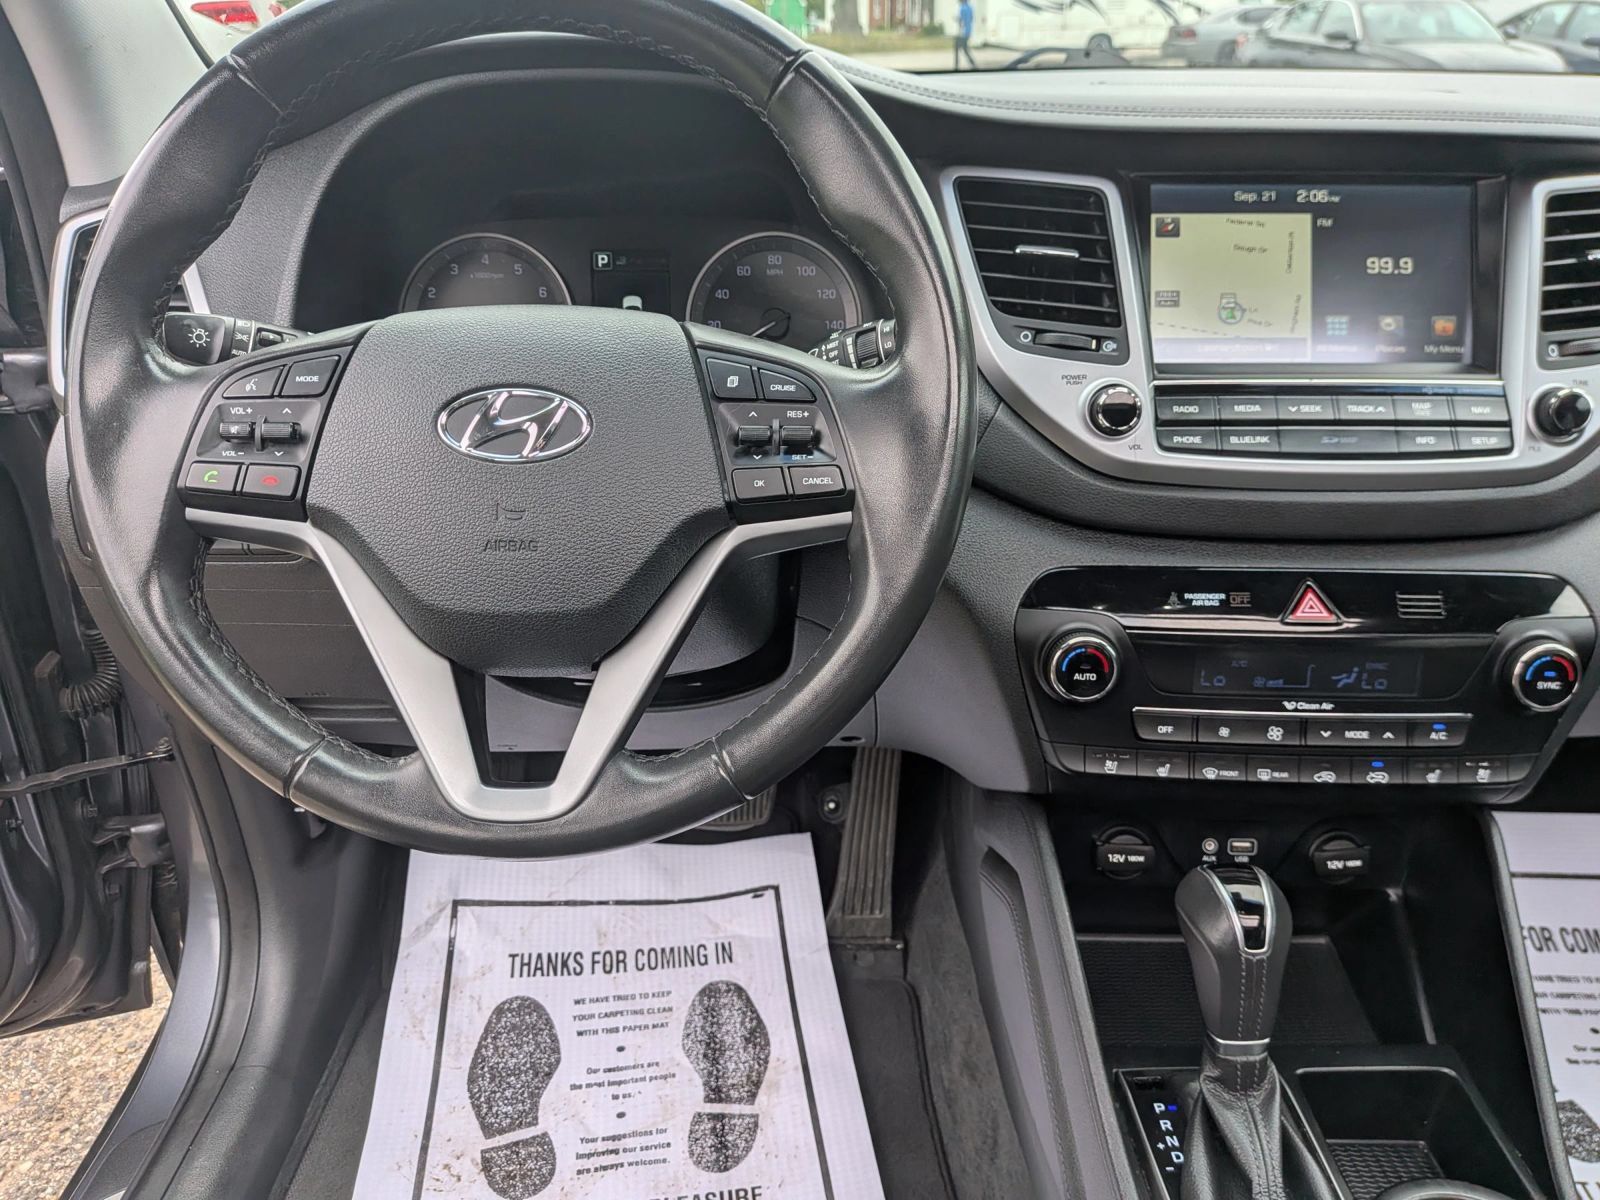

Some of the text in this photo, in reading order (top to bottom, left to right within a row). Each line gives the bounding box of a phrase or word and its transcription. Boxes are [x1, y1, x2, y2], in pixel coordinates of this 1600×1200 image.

[1261, 190, 1276, 202] 21
[1296, 189, 1329, 203] 2:06
[1316, 218, 1333, 227] FM
[481, 254, 489, 265] 4
[597, 254, 609, 268] P
[767, 255, 782, 265] 80
[450, 263, 459, 275] 3
[514, 263, 523, 275] 5
[1366, 256, 1414, 274] 99.9
[736, 266, 752, 276] 60
[796, 266, 816, 276] 100
[427, 287, 436, 298] 2
[538, 286, 548, 298] 6
[715, 289, 730, 299] 40
[817, 289, 836, 299] 120
[825, 320, 845, 330] 140
[828, 350, 839, 358] OFF
[770, 384, 796, 392] CRUISE
[1172, 405, 1198, 414] RADIO
[1234, 404, 1261, 413] MEDIA
[1300, 405, 1323, 414] SEEK
[1172, 436, 1203, 444] PHONE
[1229, 436, 1271, 444] BLUELINK
[753, 480, 765, 488] OK
[802, 477, 833, 486] CANCEL
[482, 538, 539, 553] AIRBAG
[1230, 595, 1251, 605] OFF
[1073, 673, 1097, 681] AUTO
[1537, 681, 1562, 690] SYNC
[1296, 701, 1335, 710] Clean Air
[1157, 726, 1174, 734] OFF
[1344, 730, 1370, 739] MODE
[1429, 732, 1449, 740] A/C
[1220, 770, 1239, 778] FRONT
[1107, 853, 1126, 863] 12V
[1326, 860, 1345, 870] 12V
[508, 941, 734, 979] THANKS FOR COMING IN
[573, 990, 672, 1006] WE HAVE TRIED TO KEEP
[572, 1006, 673, 1022] YOUR CARPETING CLEAN
[576, 1021, 671, 1037] WITH THIS PAPER MAT
[586, 1061, 660, 1075] Our customers are
[570, 1072, 676, 1091] the most important people
[611, 1093, 620, 1101] to
[1153, 1102, 1166, 1115] P
[1159, 1119, 1174, 1132] R
[579, 1127, 668, 1144] Your suggestions for
[1165, 1135, 1180, 1148] N
[622, 1146, 638, 1154] our
[640, 1141, 672, 1152] service
[1171, 1151, 1185, 1164] D
[576, 1157, 671, 1176] are always welcome.
